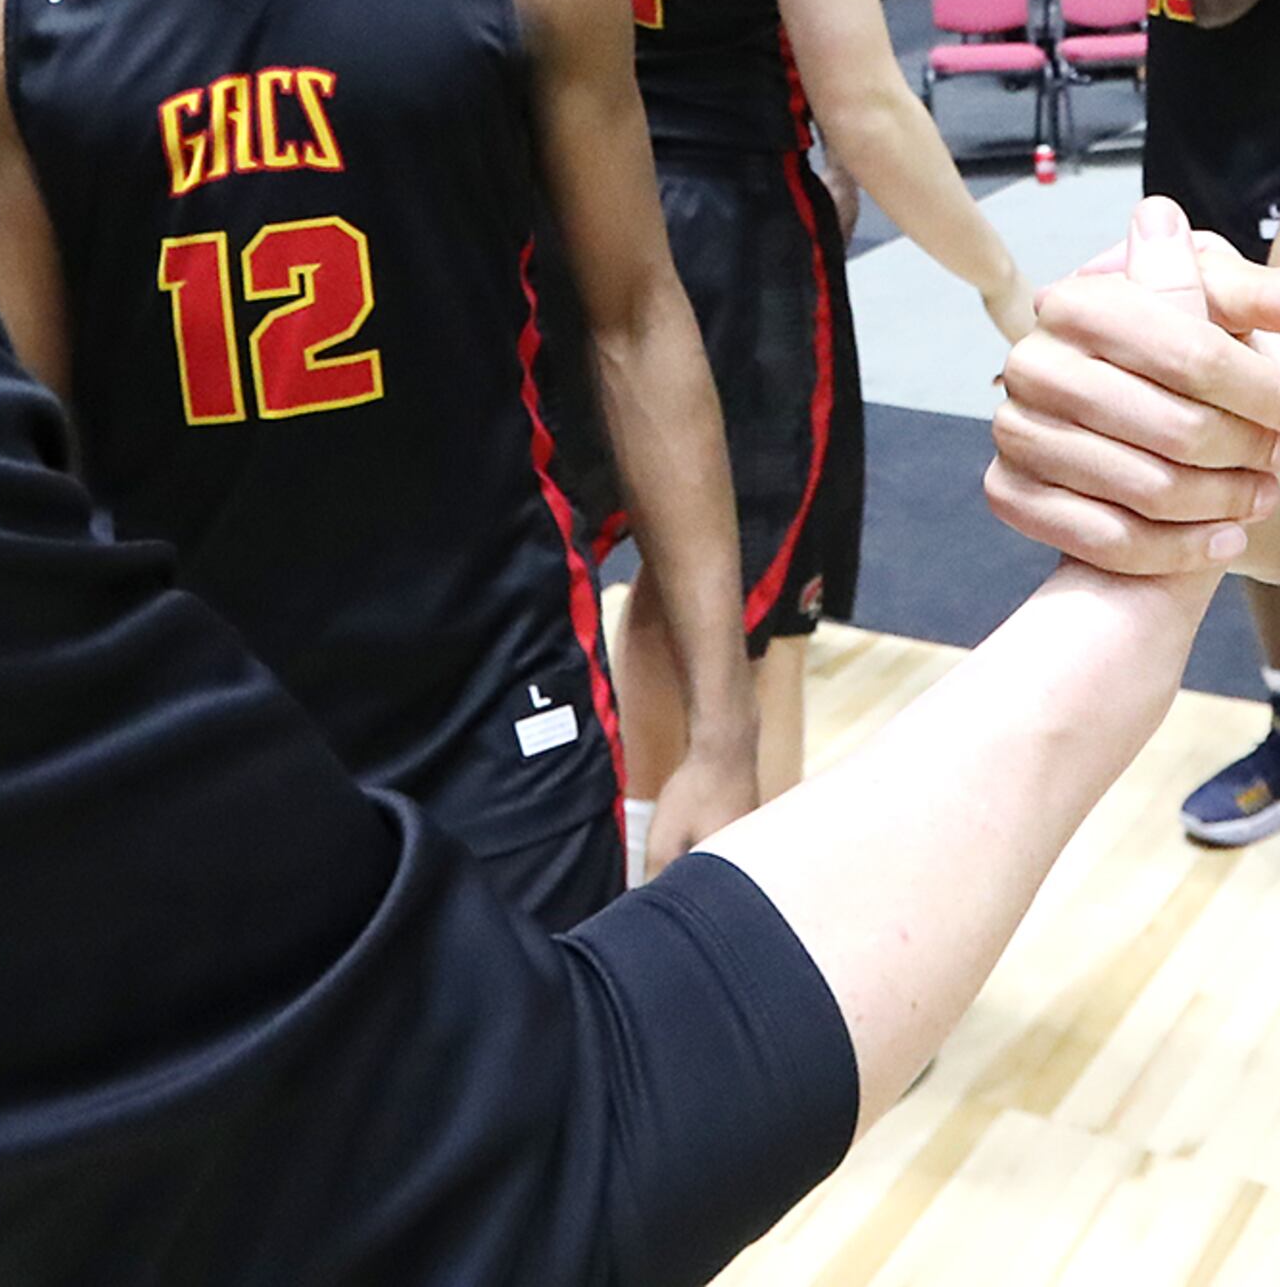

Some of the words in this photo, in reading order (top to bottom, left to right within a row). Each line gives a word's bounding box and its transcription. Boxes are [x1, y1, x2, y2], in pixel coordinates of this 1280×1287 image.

[157, 65, 345, 198] GACS
[158, 216, 384, 426] 12
[528, 684, 552, 709] L
